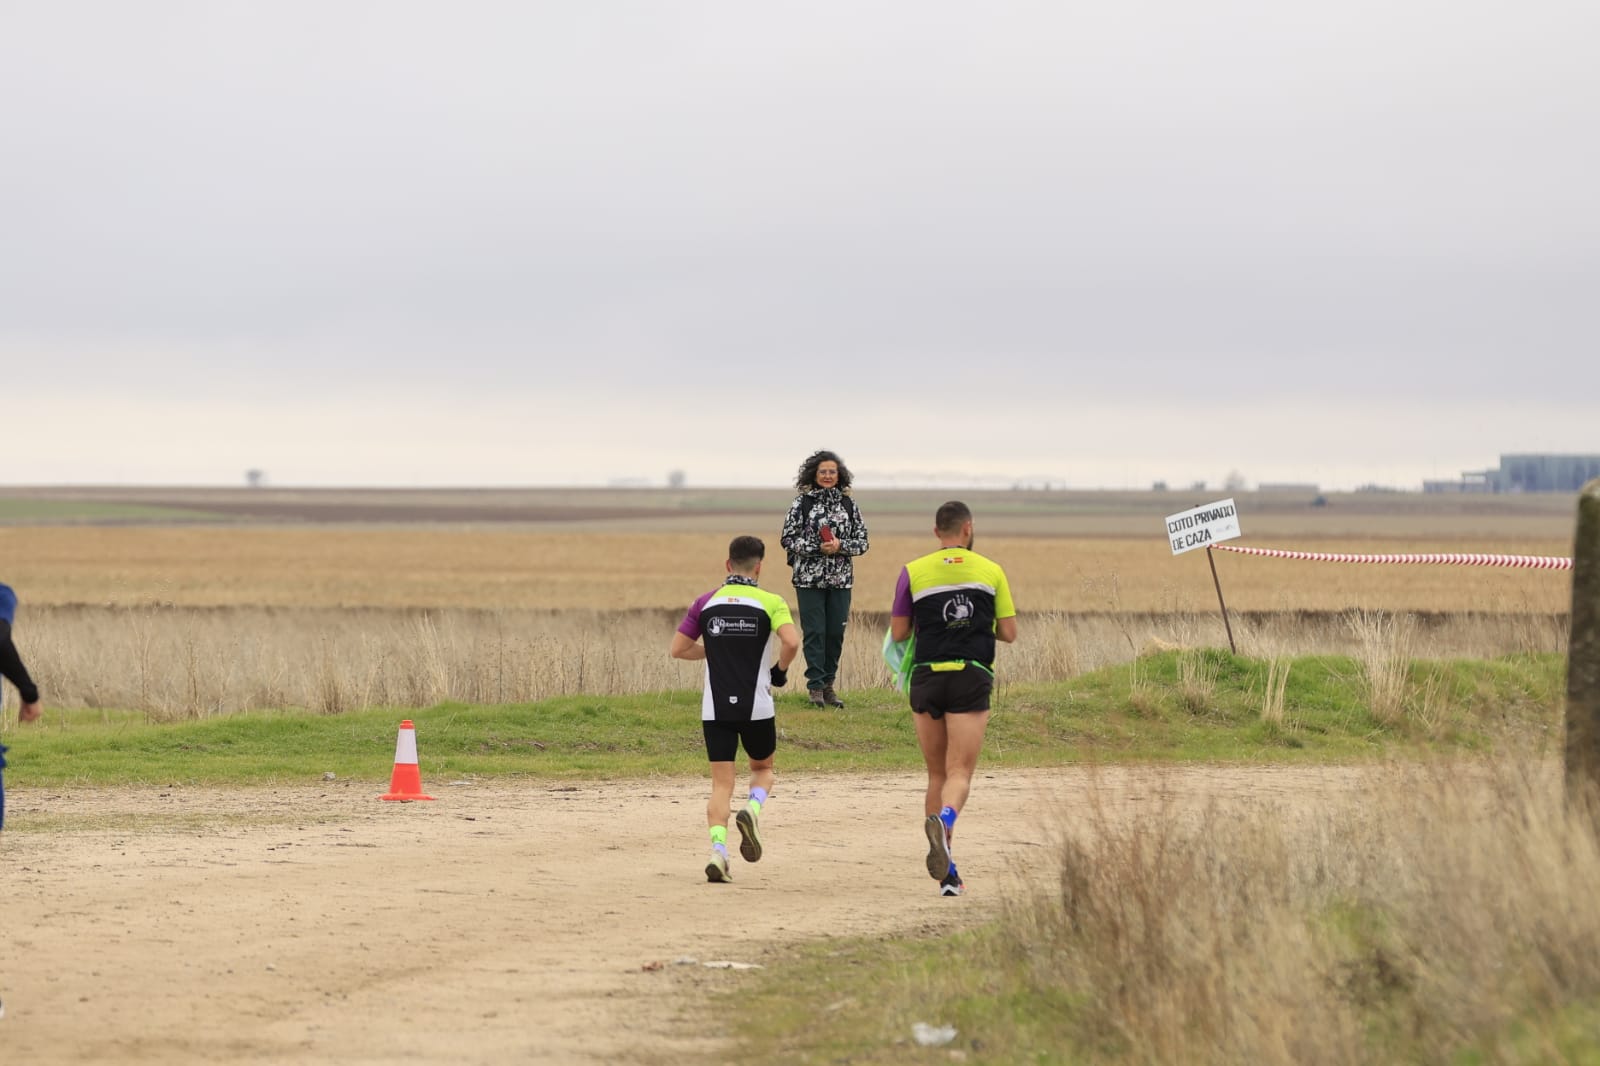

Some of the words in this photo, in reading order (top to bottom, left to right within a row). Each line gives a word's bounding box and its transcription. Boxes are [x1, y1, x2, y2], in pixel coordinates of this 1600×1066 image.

[1168, 516, 1193, 534] COTO
[1194, 505, 1234, 526] PRIVADO
[1172, 537, 1184, 551] DE
[1185, 528, 1212, 547] CAZA
